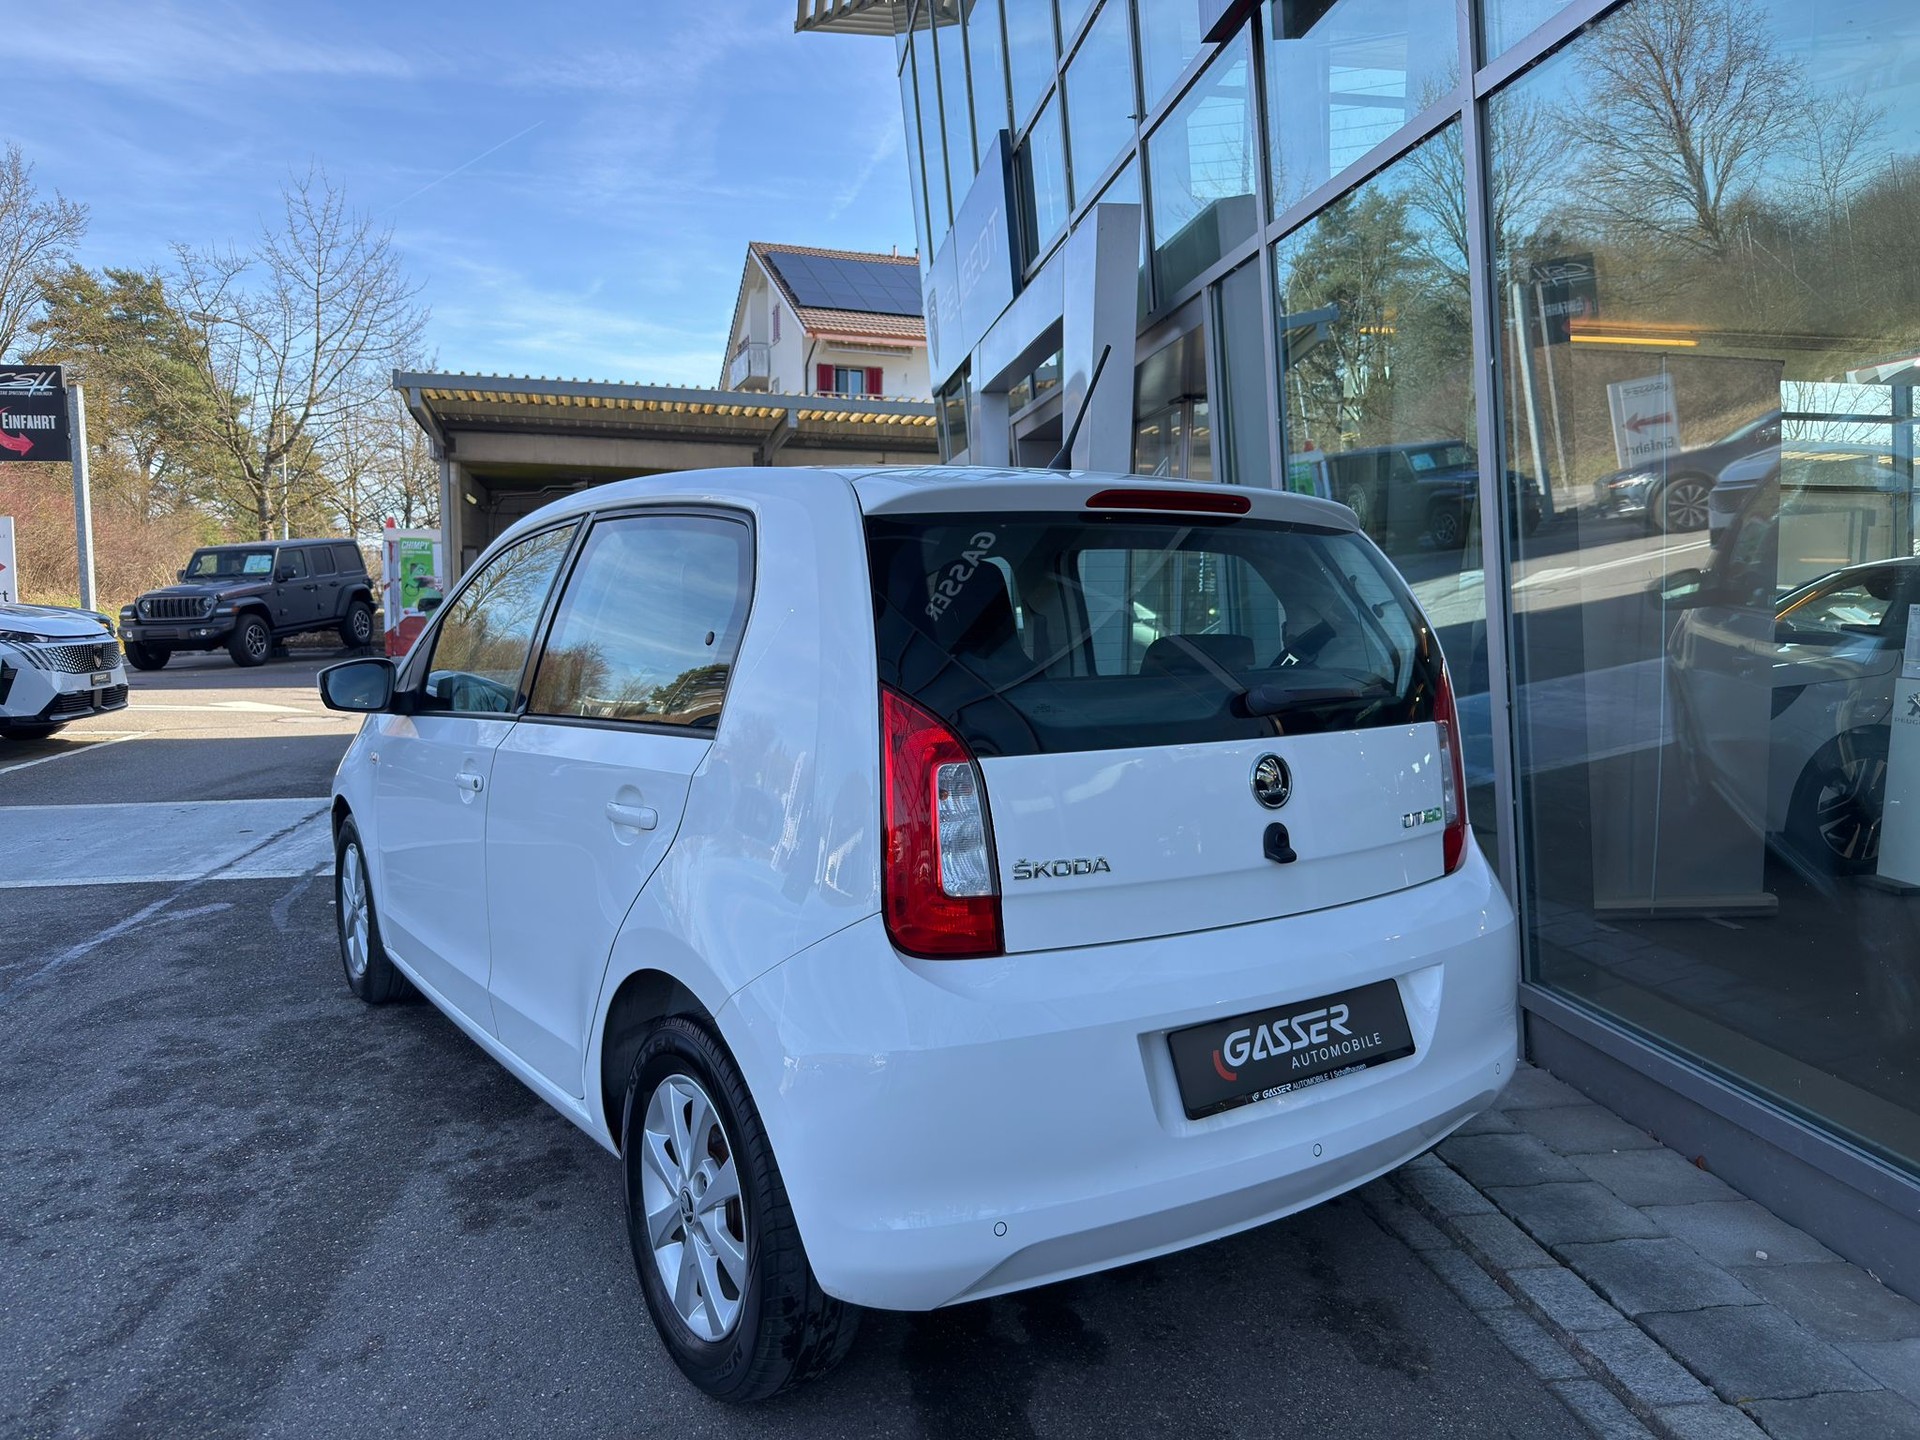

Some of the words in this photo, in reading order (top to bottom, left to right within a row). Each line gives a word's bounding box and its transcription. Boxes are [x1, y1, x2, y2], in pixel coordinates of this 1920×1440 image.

[1012, 856, 1111, 880] ŠKODA
[1223, 1003, 1352, 1067] GASSER
[1291, 1032, 1383, 1069] AUTOMOBILE
[1262, 1083, 1292, 1098] GASSER
[1292, 1073, 1329, 1091] AUTOMOBILE
